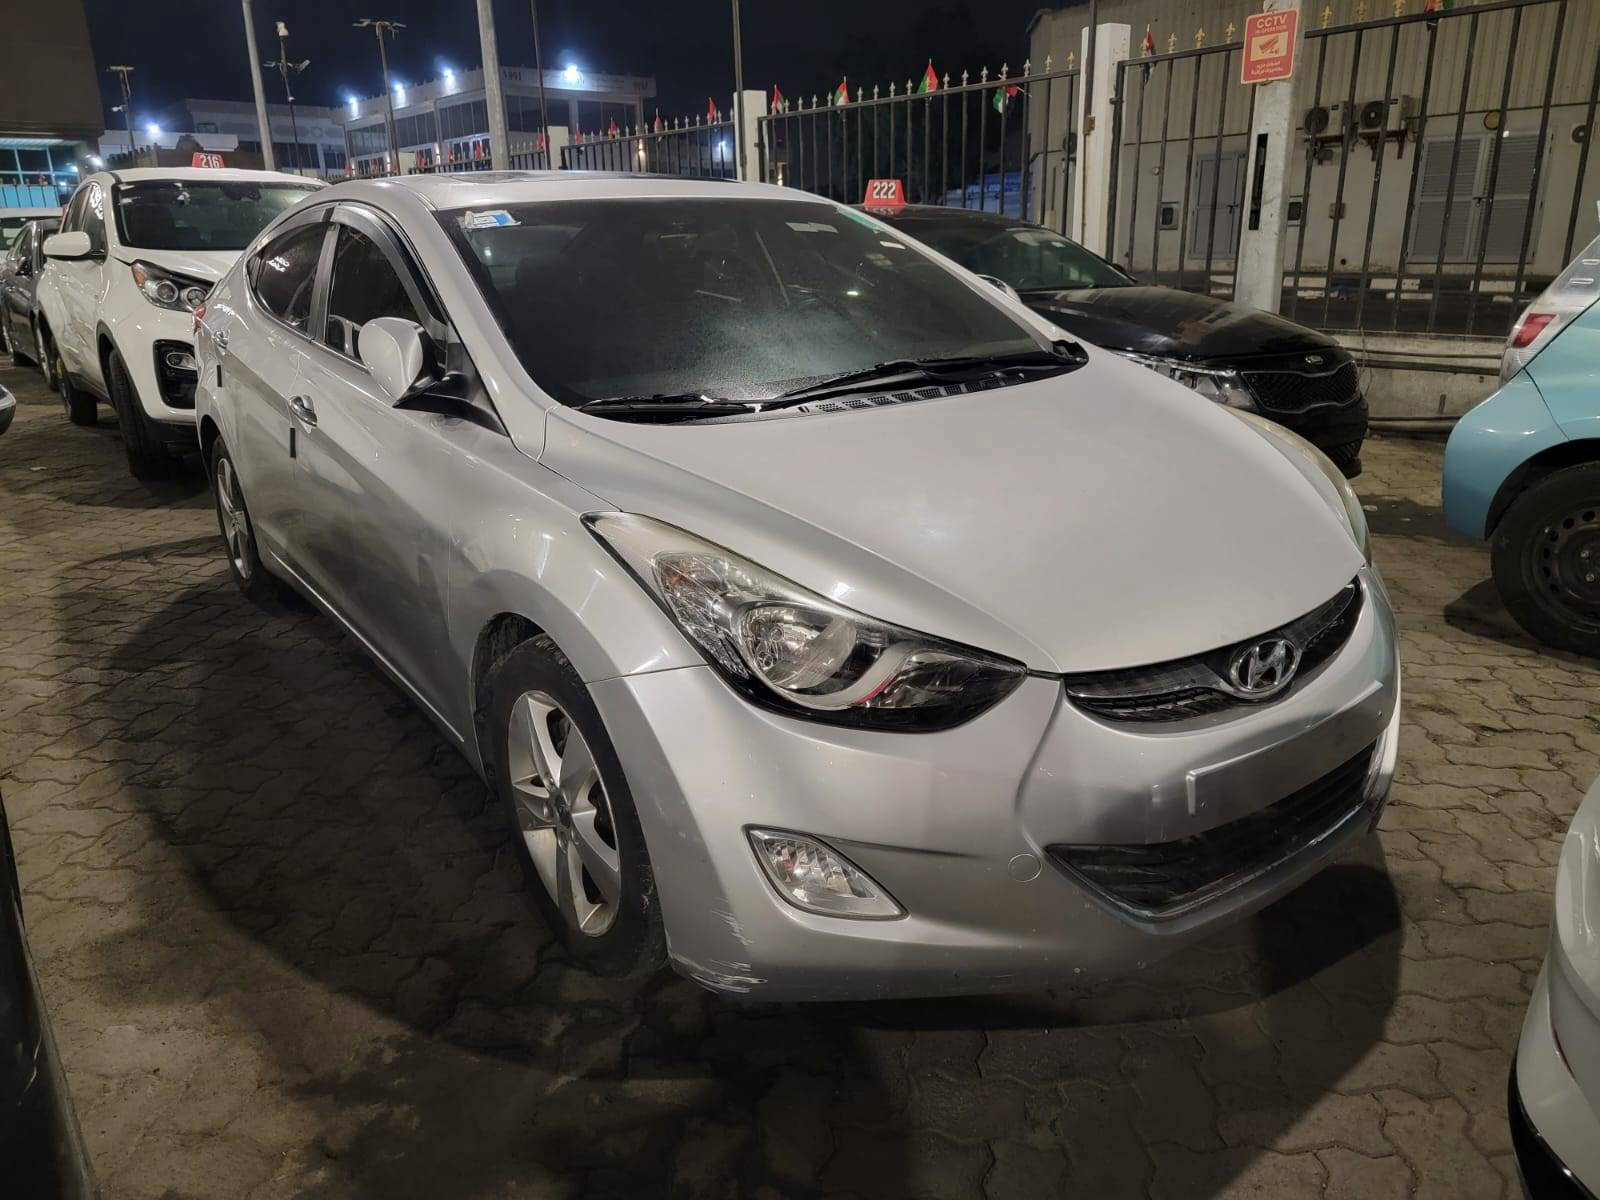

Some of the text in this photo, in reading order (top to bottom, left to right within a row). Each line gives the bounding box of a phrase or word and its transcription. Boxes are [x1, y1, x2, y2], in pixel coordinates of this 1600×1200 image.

[1256, 14, 1288, 28] CCTV
[200, 154, 220, 168] 216
[873, 182, 896, 199] 222
